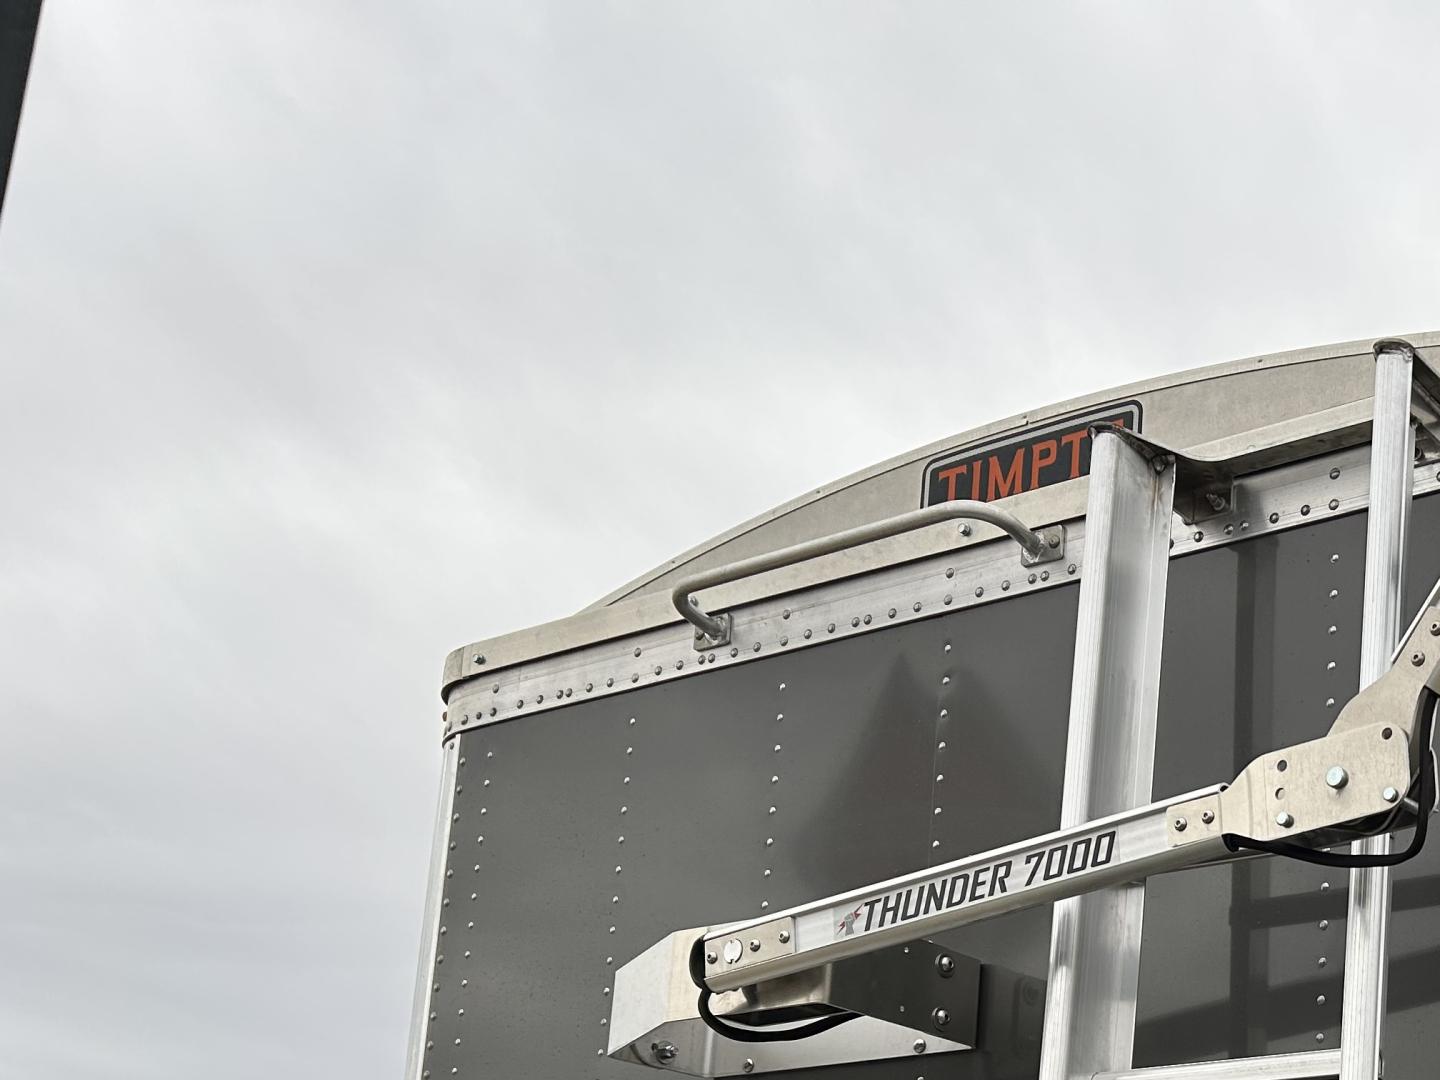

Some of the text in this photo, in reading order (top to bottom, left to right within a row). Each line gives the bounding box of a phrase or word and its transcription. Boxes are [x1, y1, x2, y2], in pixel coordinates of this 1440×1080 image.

[938, 418, 1123, 503] TIMPT
[864, 830, 1116, 931] THUNDER 7000
